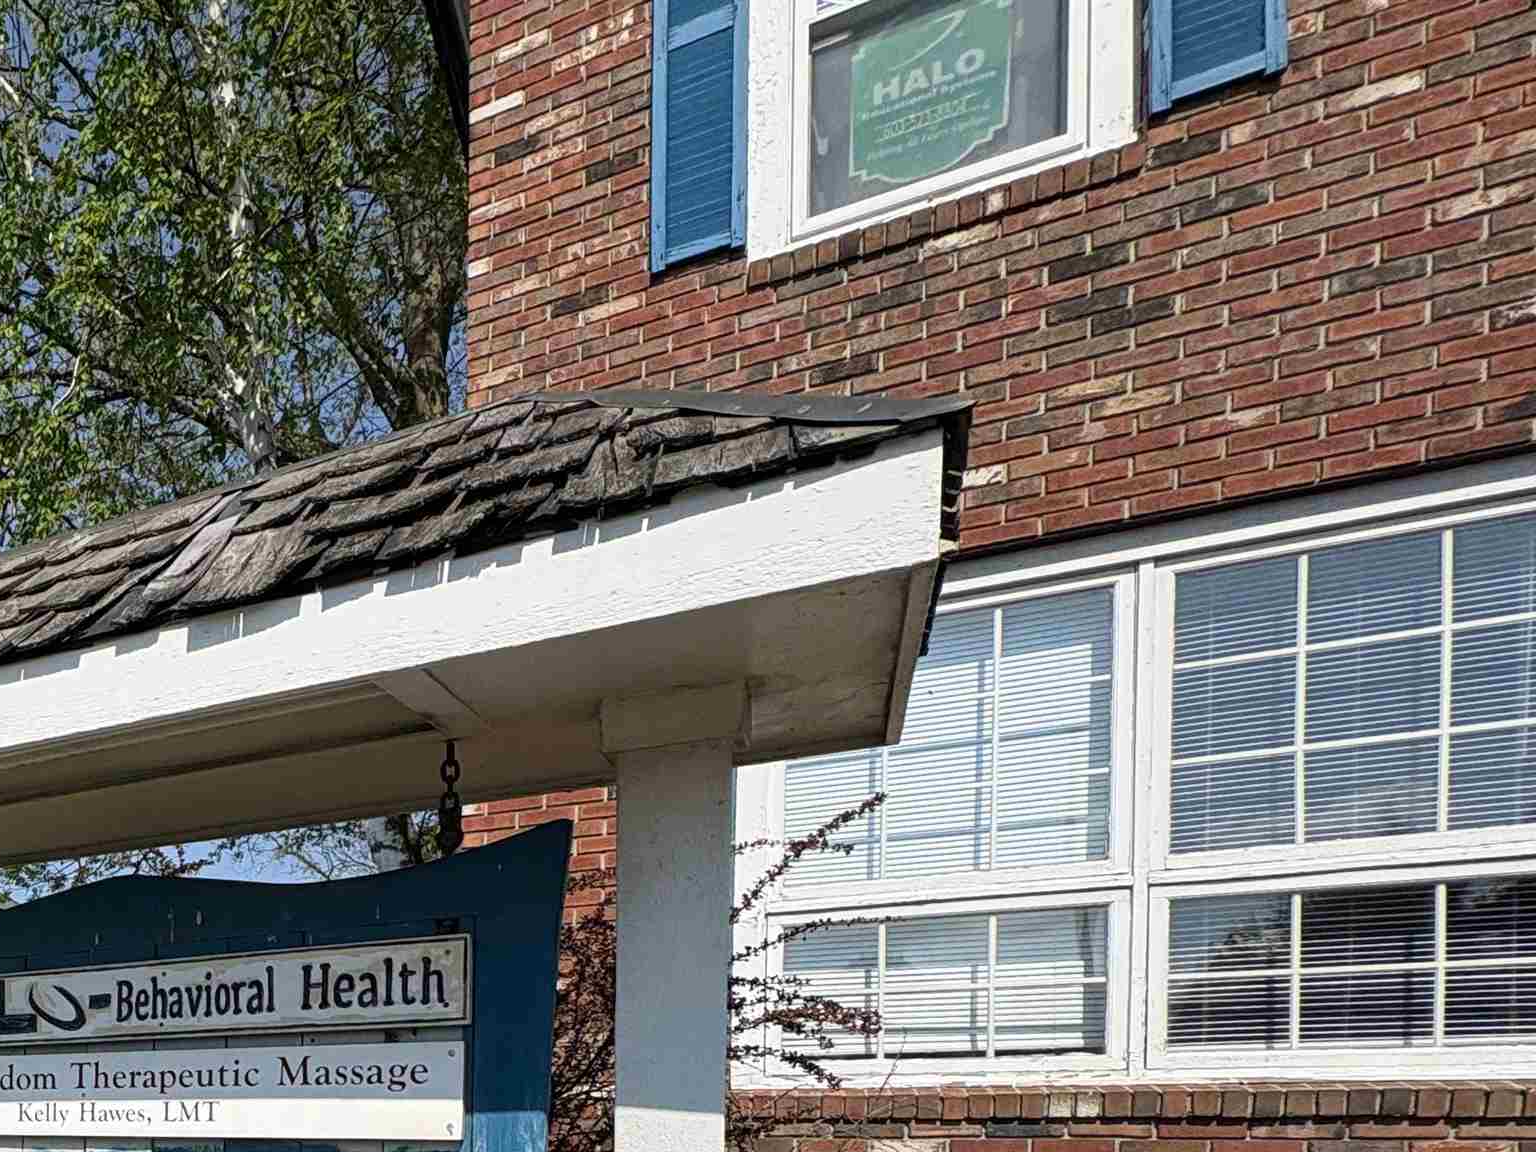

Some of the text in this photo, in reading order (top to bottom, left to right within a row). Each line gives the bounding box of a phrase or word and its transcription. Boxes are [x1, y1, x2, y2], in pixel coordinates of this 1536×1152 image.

[873, 49, 985, 105] HALO
[301, 956, 449, 1010] Health
[71, 1060, 261, 1094] Therapeutic
[276, 1055, 429, 1092] Massage
[18, 1101, 220, 1125] Kelly Hawes, LMT
